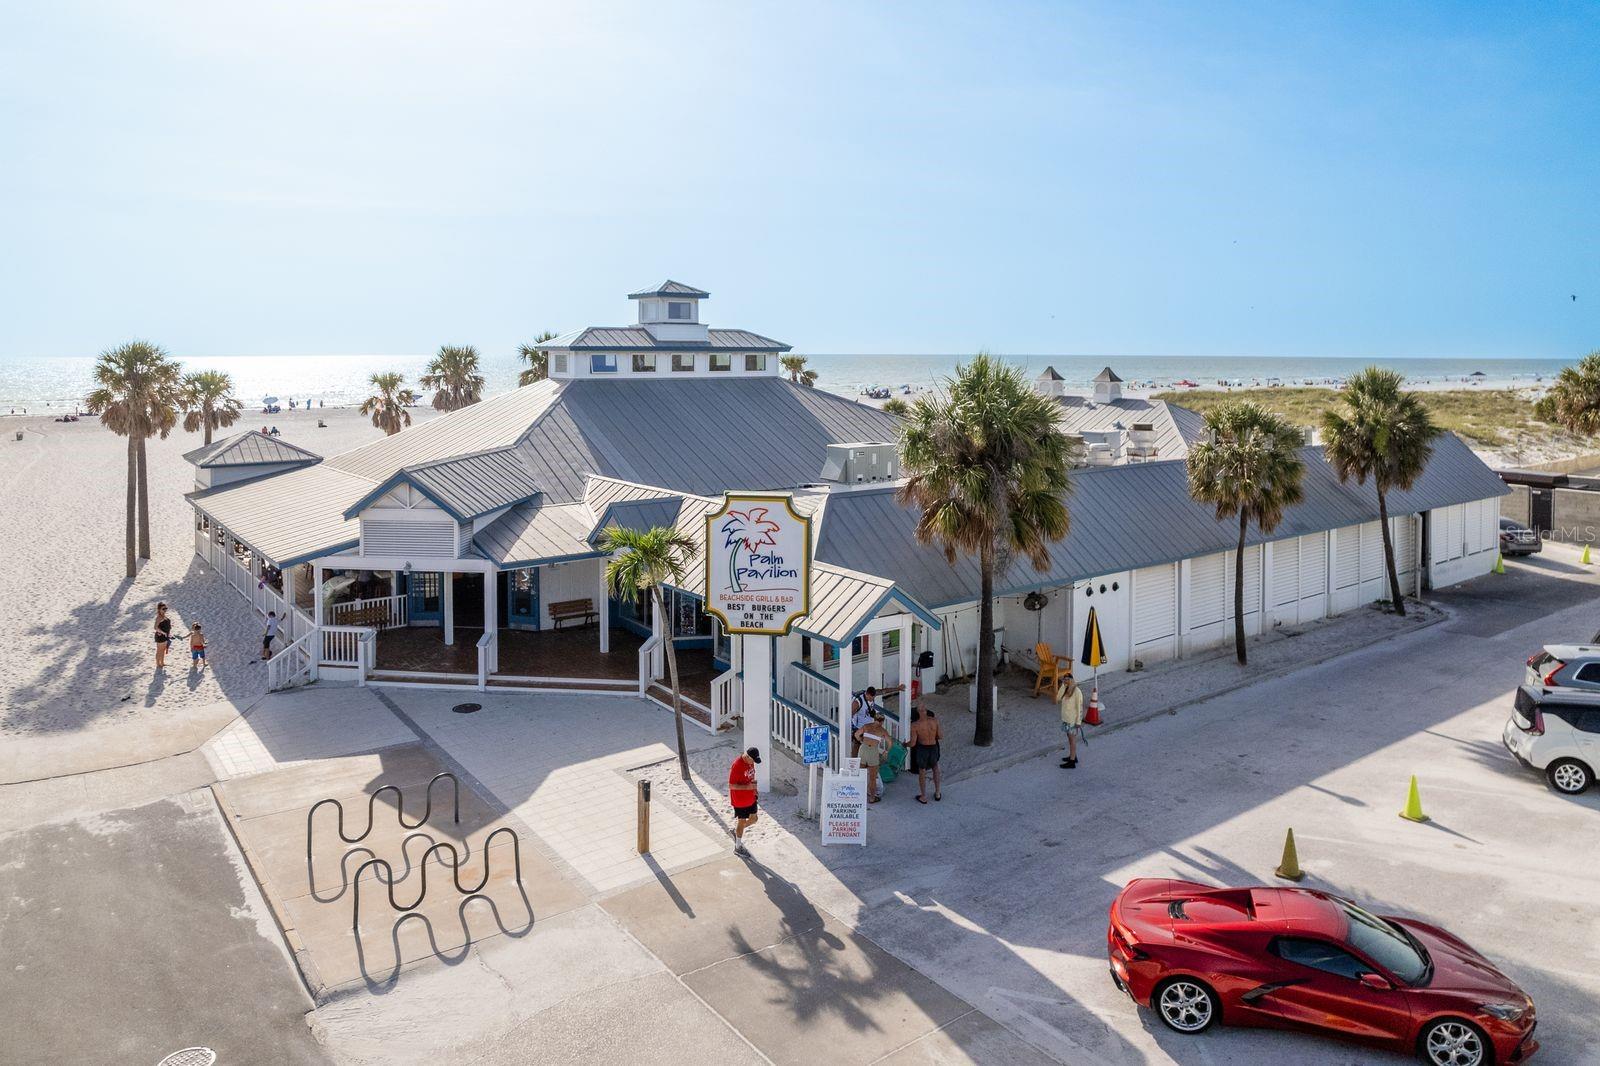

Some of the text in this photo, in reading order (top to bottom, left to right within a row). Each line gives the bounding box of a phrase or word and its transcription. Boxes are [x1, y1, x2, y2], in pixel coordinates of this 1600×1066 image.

[749, 550, 784, 567] Palm
[737, 564, 798, 580] Pavilion
[720, 594, 754, 602] BEACHSIDE
[755, 594, 773, 603] GRILL
[775, 595, 780, 603] &
[727, 603, 786, 613] BEST BURGERS
[743, 612, 774, 621] ON THE
[740, 620, 764, 629] BEACH
